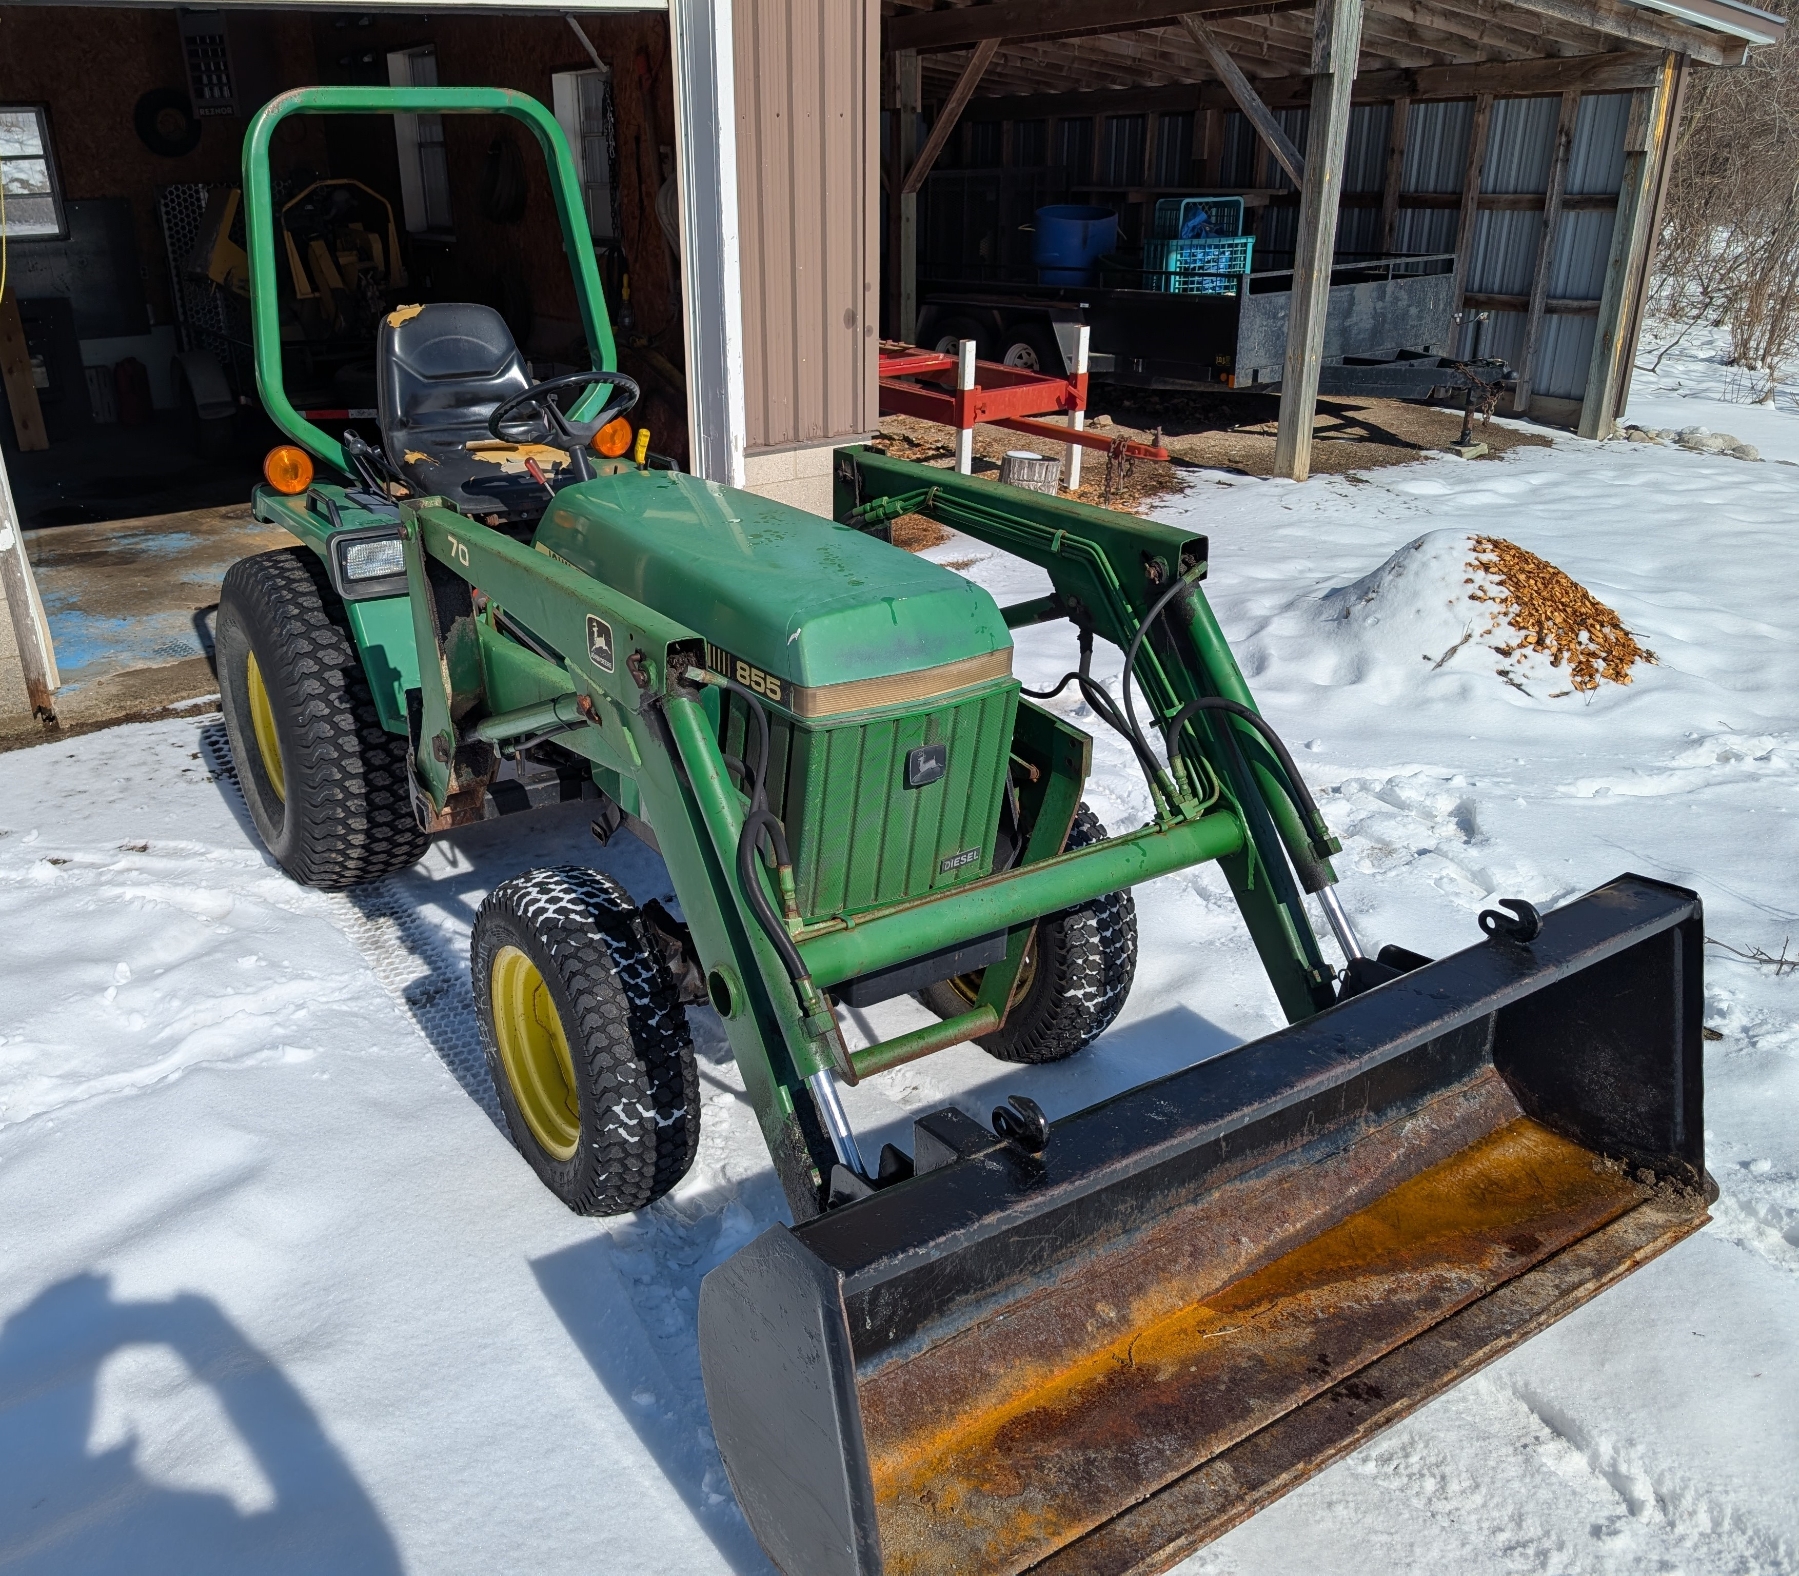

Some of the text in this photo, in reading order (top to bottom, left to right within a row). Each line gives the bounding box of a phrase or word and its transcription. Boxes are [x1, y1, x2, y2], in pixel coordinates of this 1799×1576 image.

[199, 107, 233, 116] REZNOR
[447, 534, 469, 567] 70
[736, 660, 781, 701] 855
[944, 851, 979, 871] DIESEL
